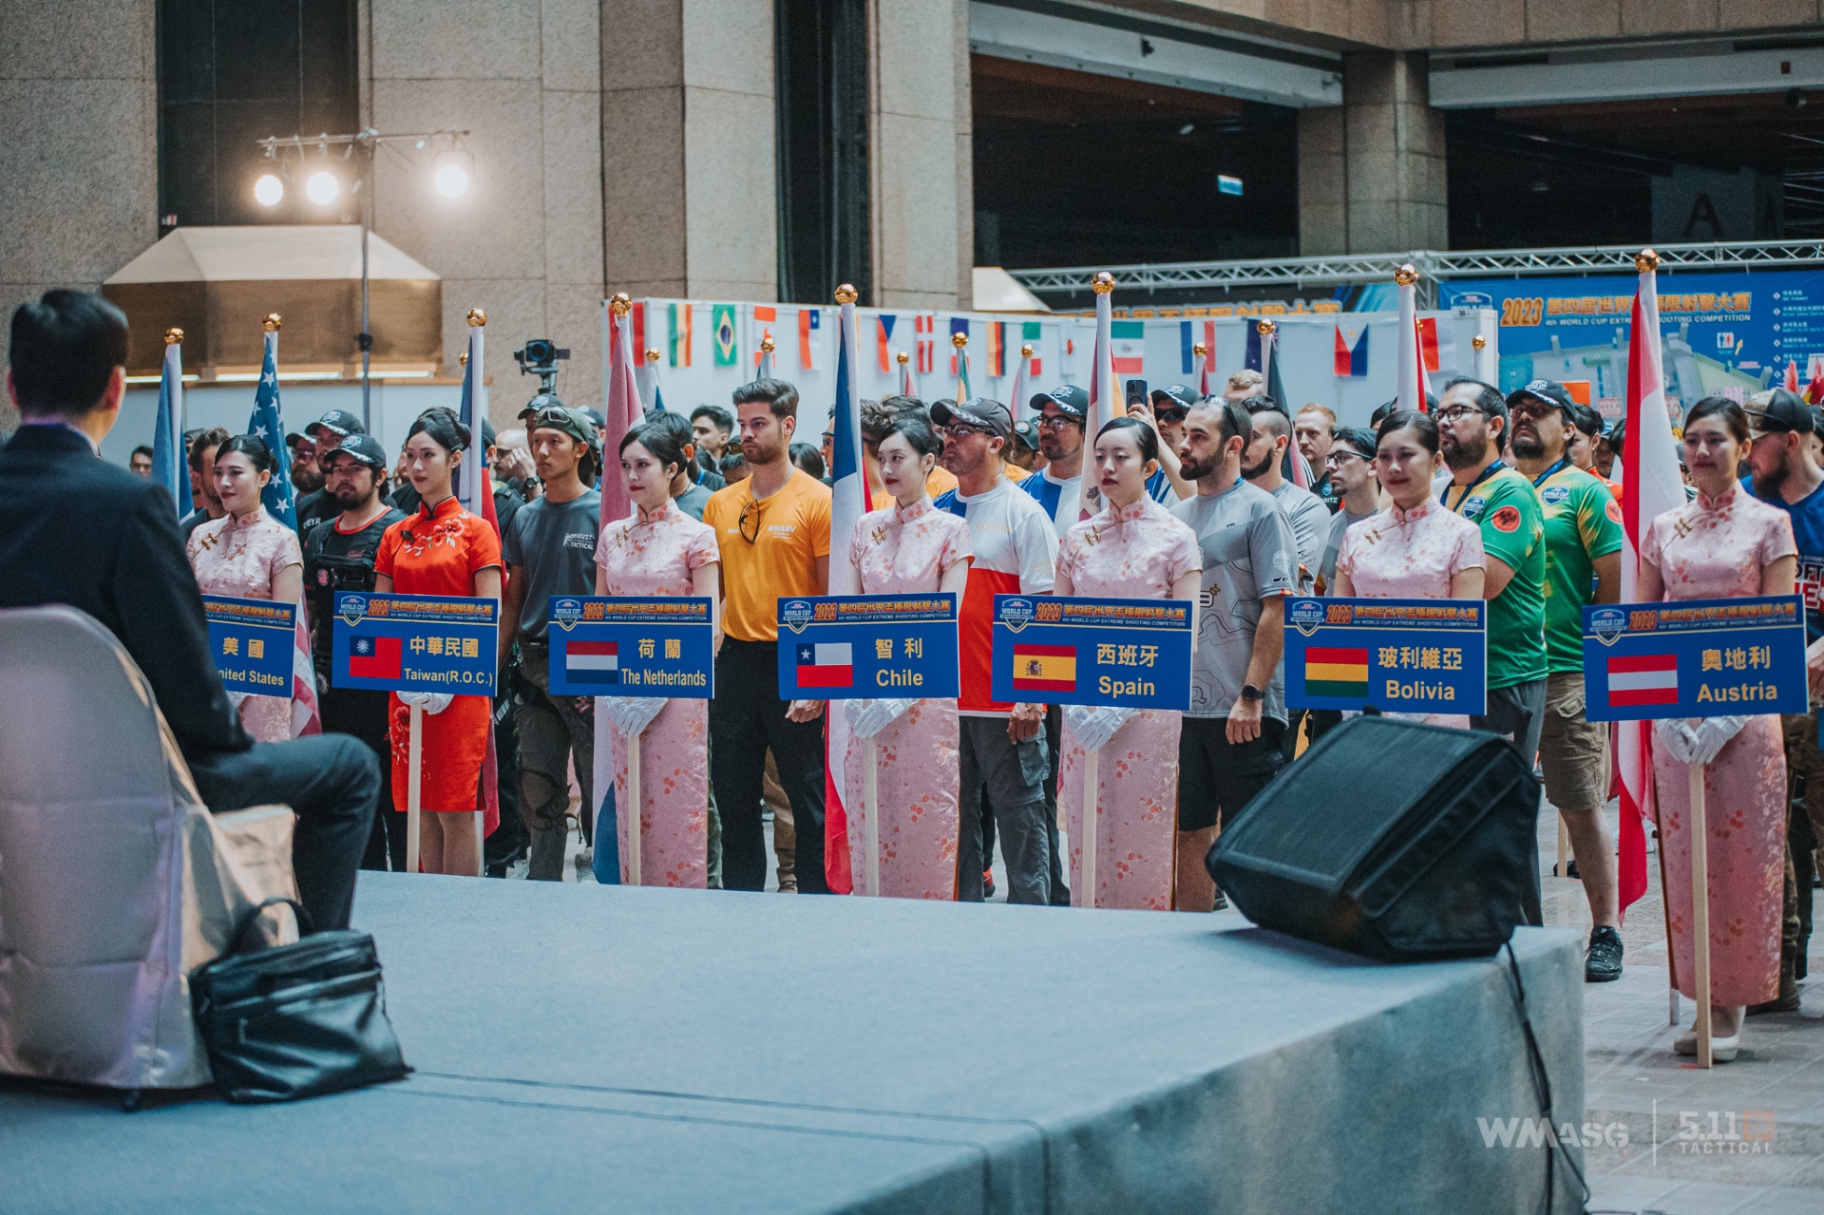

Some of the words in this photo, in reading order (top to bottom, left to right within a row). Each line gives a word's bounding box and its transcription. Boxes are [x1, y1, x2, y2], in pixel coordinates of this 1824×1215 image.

[1500, 297, 1544, 327] 2023
[1546, 291, 1752, 315] 第四屆世界限射擊大賽
[1695, 314, 1751, 322] COMPETITION
[570, 542, 594, 550] TACTICAL
[367, 599, 390, 616] 2023
[582, 602, 605, 620] 2023
[814, 603, 837, 621] 2023
[1034, 602, 1062, 622] 2023
[1326, 604, 1352, 624] 2023
[1628, 610, 1658, 631] 2023
[223, 637, 264, 659] 美國
[410, 636, 479, 658] 中華民國
[638, 638, 681, 659] 荷蘭
[875, 637, 922, 659] 智利
[1097, 643, 1158, 667] 西班牙
[1378, 646, 1462, 670] 玻利維亞
[1702, 645, 1770, 672] 奧地利
[218, 668, 245, 683] nited
[249, 669, 284, 686] States
[404, 668, 493, 687] Taiwan(R.O.C.)
[621, 668, 640, 684] The
[644, 669, 706, 686] Netherlands
[876, 669, 923, 687] Chile
[1099, 676, 1155, 698] Spain
[1386, 679, 1455, 700] Bolivia
[1697, 681, 1778, 703] Austria
